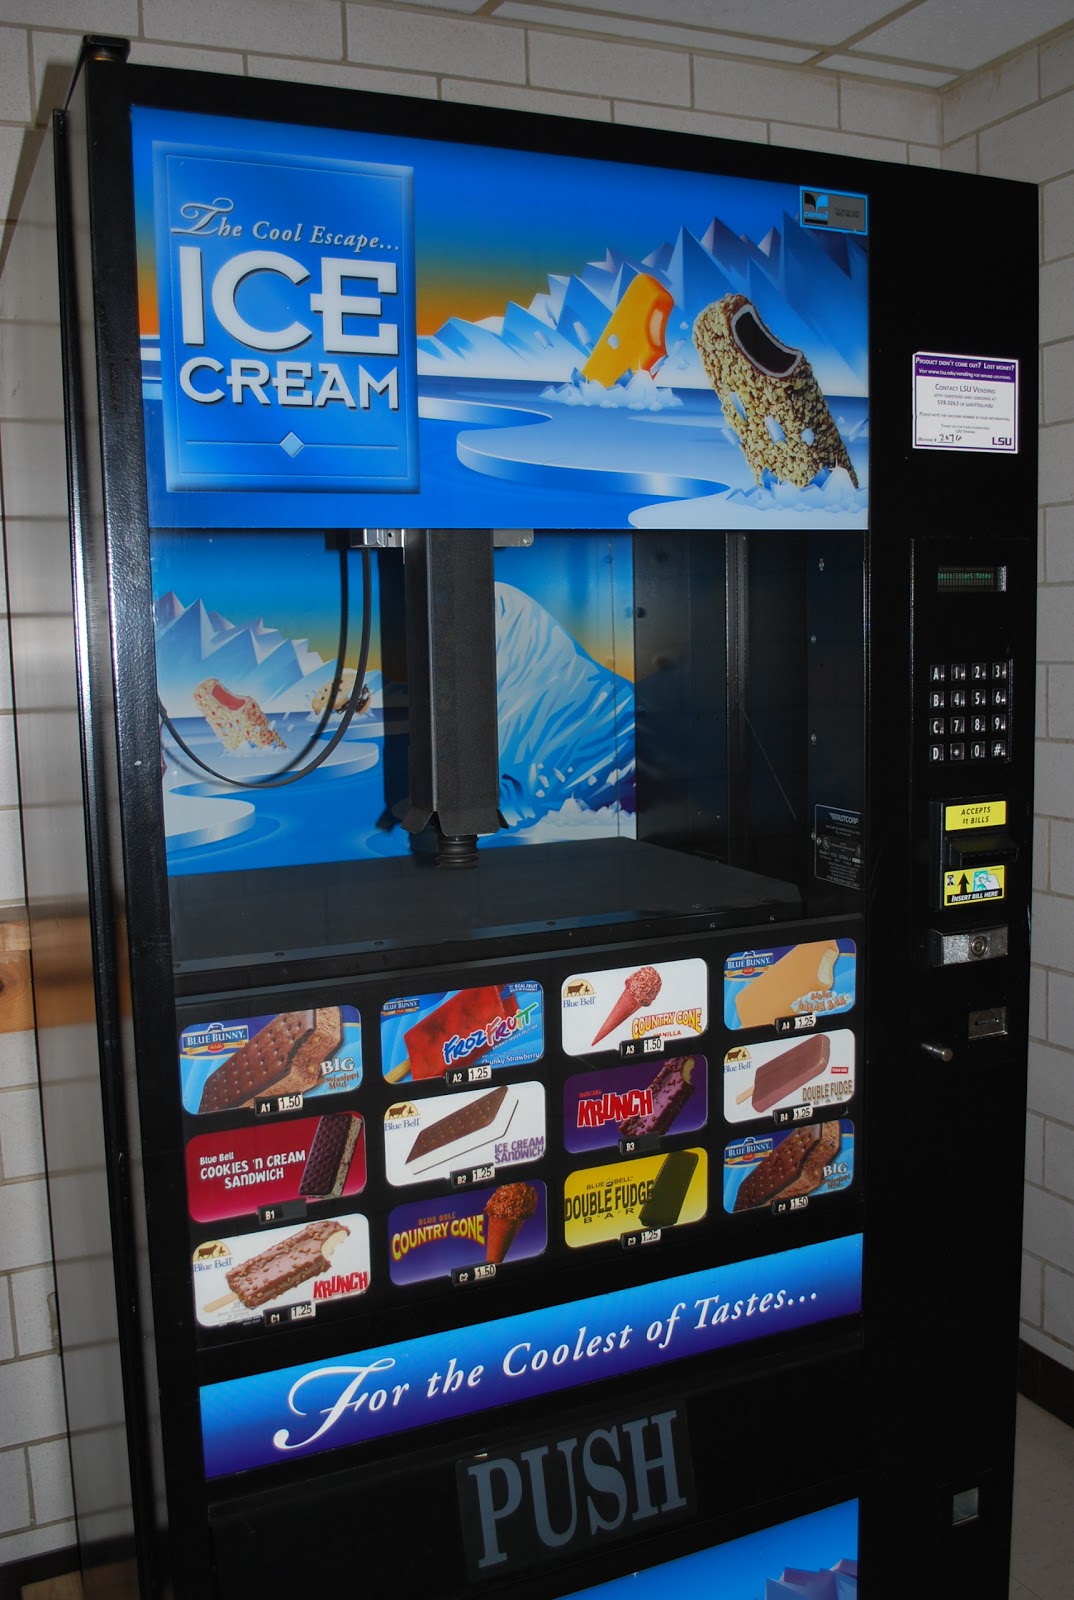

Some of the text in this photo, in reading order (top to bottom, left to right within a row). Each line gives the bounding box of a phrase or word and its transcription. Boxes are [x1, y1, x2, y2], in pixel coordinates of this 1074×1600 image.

[170, 198, 399, 253] The Cool Escape...
[180, 246, 399, 356] ICE
[916, 357, 938, 365] PRODUCT
[180, 356, 399, 410] CREAM
[973, 386, 995, 394] VENDING
[992, 437, 1012, 445] LSU
[933, 665, 1000, 680] A 1 2 3
[933, 691, 1000, 707] B 4 5 6
[933, 717, 999, 734] C 7 8 9
[933, 747, 939, 760] D
[974, 745, 979, 757] 0
[961, 806, 991, 815] ACCEPTS
[971, 816, 989, 824] BILLS
[951, 894, 971, 902] INSERT
[972, 892, 983, 900] BILL
[728, 960, 745, 969] BLUE
[563, 997, 595, 1008] Blue Bell
[632, 1008, 702, 1040] COUNTRY CONE
[782, 1016, 813, 1030] A4 1.25
[187, 1035, 211, 1045] BLUE
[626, 1038, 662, 1054] A3 1.50
[506, 1053, 540, 1062] Strawberry
[320, 1058, 354, 1075] BIG
[724, 1061, 752, 1073] Blue Bell
[452, 1068, 487, 1083] A2 1.25
[803, 1080, 852, 1100] DOUBLE FUDGE
[260, 1096, 300, 1113] A1 1.50
[577, 1088, 654, 1128] KRUNCH
[780, 1108, 810, 1122] B4 1.25
[384, 1118, 420, 1131] Blue Bell
[495, 1136, 544, 1154] ICE CREAM
[626, 1142, 635, 1151] B3
[728, 1148, 746, 1157] BLUE
[200, 1152, 234, 1165] Blue Bell
[495, 1146, 544, 1164] SANDWICH
[200, 1160, 248, 1180] COOKIES
[267, 1150, 306, 1168] CREAM
[822, 1162, 847, 1177] BIG
[224, 1168, 284, 1189] SANDWICH
[457, 1167, 491, 1185] B2 1.25
[586, 1182, 604, 1190] BLUE
[565, 1180, 654, 1221] DOUBLE FUDGE
[791, 1197, 807, 1209] 1.50
[265, 1210, 275, 1220] B1
[418, 1212, 456, 1226] BLUE BELL
[392, 1214, 485, 1261] COUNTRY CONE
[642, 1231, 658, 1242] 1.25
[194, 1257, 232, 1272] Blue Bell
[460, 1265, 495, 1282] C2 1.50
[313, 1271, 368, 1300] KRUNCH
[271, 1313, 280, 1323] C1
[292, 1304, 312, 1316] 1.25
[274, 1286, 818, 1450] For the Coolest of Tastes...
[468, 1410, 687, 1568] PUSH
